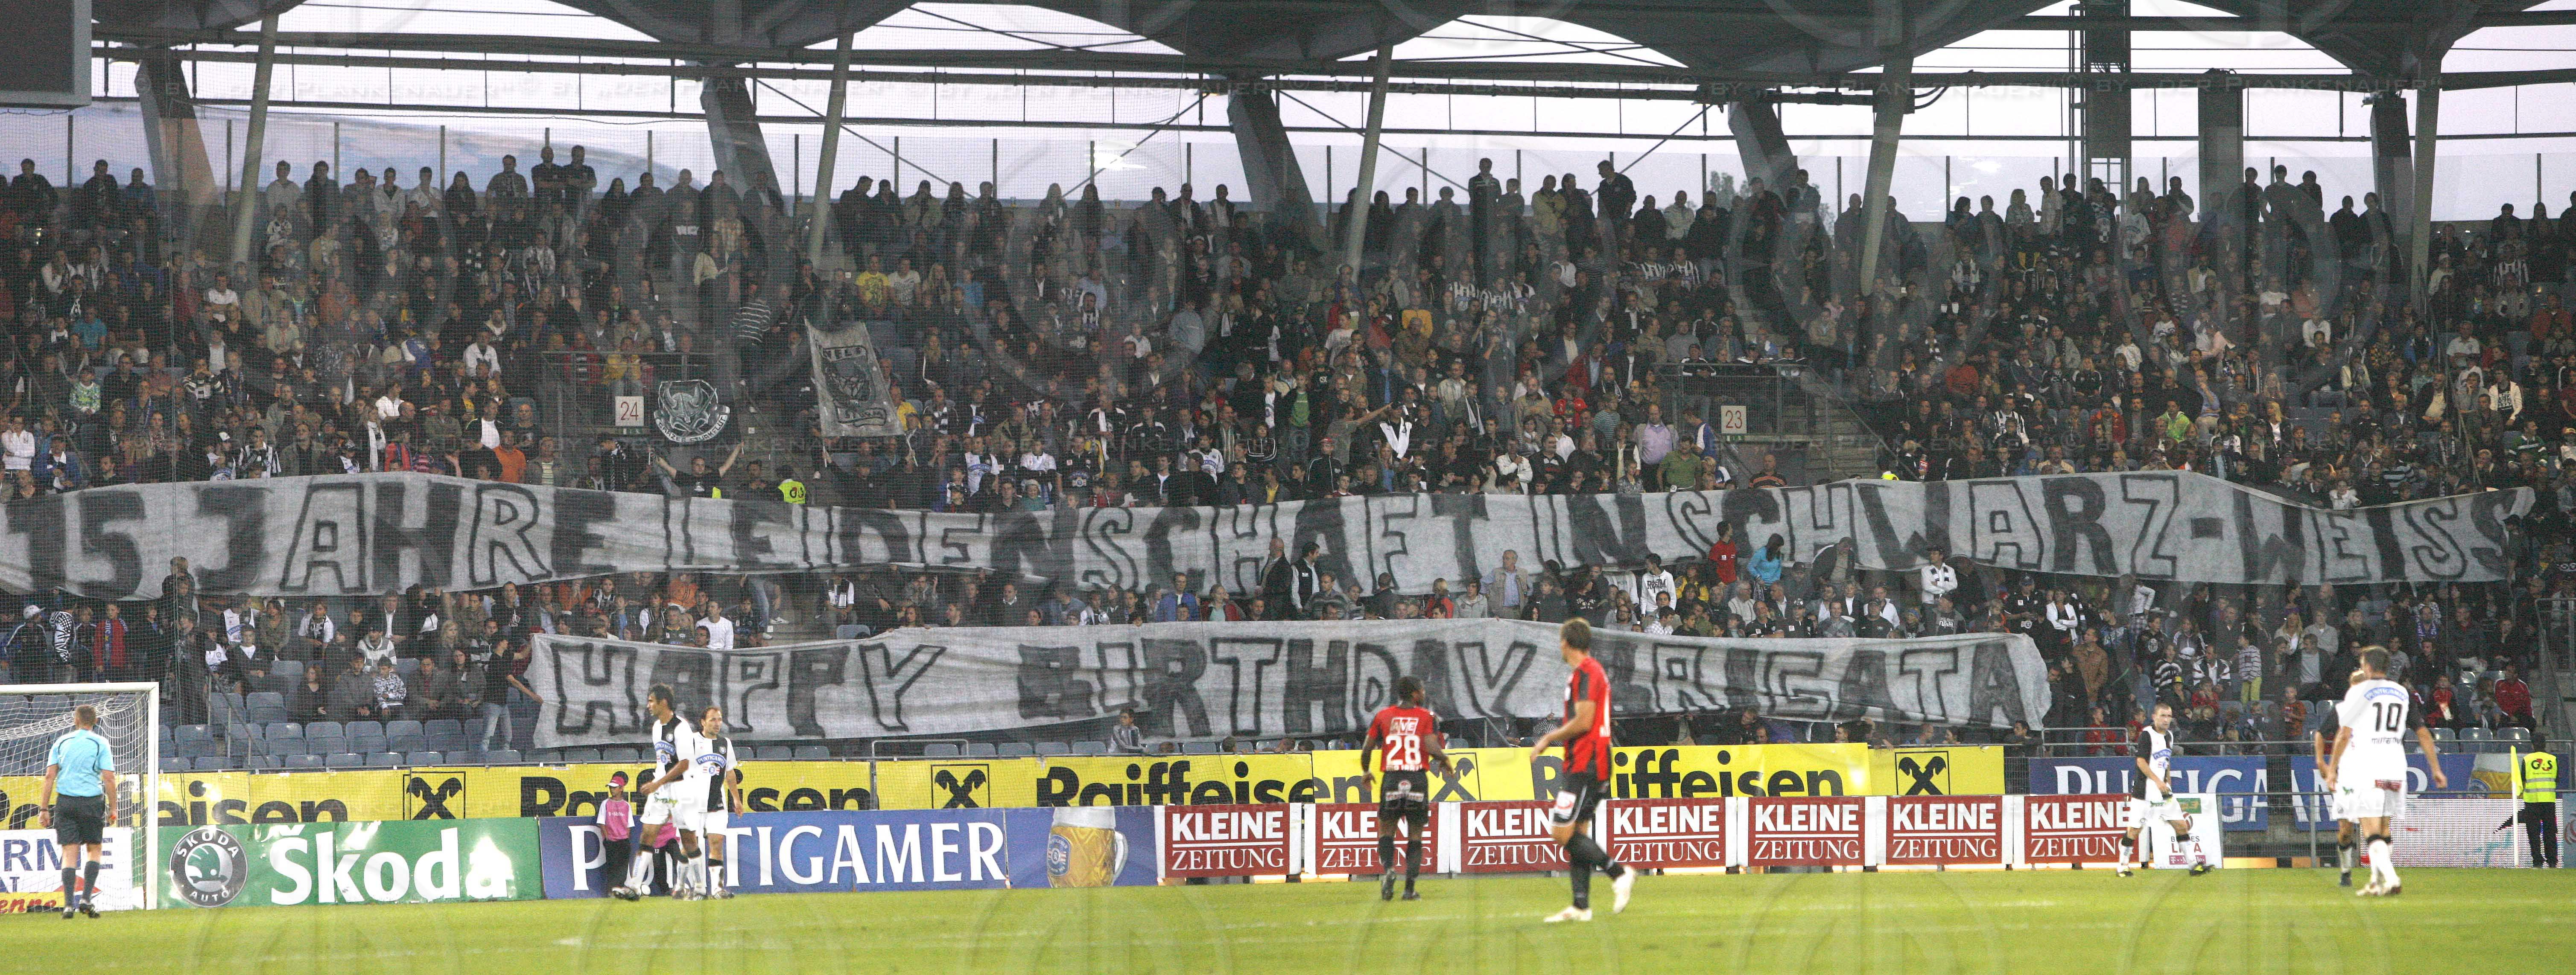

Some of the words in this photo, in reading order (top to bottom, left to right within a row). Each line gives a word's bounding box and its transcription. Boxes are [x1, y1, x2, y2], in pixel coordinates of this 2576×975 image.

[620, 401, 639, 421] 24
[1726, 410, 1743, 428] 23
[6, 489, 145, 601] 15
[193, 482, 616, 593] JAHRE
[663, 492, 1491, 597] LEIDENSCHAFT
[550, 641, 946, 737] HAPPY
[1016, 637, 1537, 738] BIRTHDAY
[1590, 640, 2035, 726] BRIGATA
[2372, 702, 2403, 732] 10
[1386, 735, 1421, 765] 28
[1037, 760, 1372, 807] Raiffeisen
[1531, 749, 1843, 800] Riffeisen
[1172, 811, 1283, 841] KLEINE
[1468, 808, 1555, 837] KLEIN
[1614, 806, 1719, 835] KLEINE
[1755, 804, 1859, 832] KLEINE
[1893, 803, 1996, 831] KLEINE
[1172, 847, 1284, 870] ZEITUNG
[1322, 847, 1432, 868] ZEITNG
[1613, 842, 1720, 863] ZEITUNG
[1755, 840, 1860, 860] ZEITUNG
[1892, 839, 1997, 859] ZEITUNG
[269, 824, 507, 906] Škoda
[190, 889, 230, 902] AUTO
